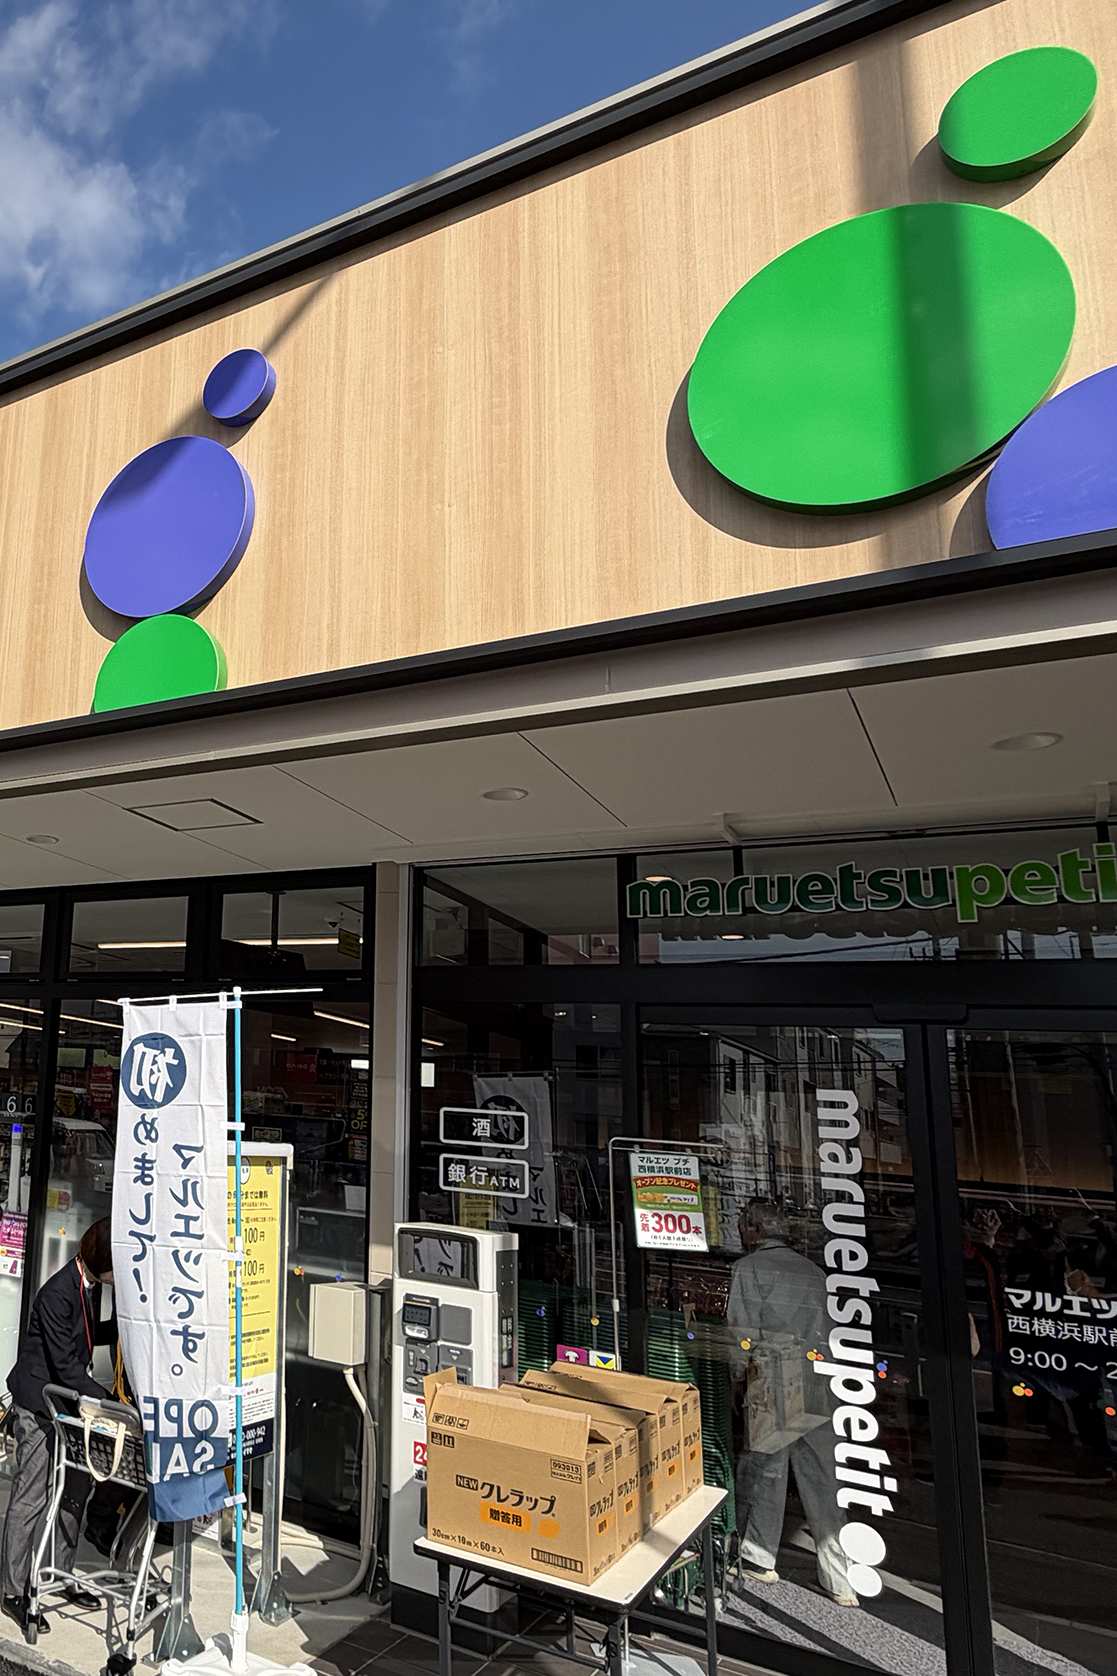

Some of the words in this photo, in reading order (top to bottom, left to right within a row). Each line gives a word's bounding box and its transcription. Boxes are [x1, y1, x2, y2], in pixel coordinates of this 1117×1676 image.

[6, 1095, 17, 1113] 6
[24, 1097, 33, 1114] 6
[472, 1117, 491, 1137] 酒
[637, 1156, 669, 1165] マルエツ
[637, 1165, 692, 1176] 西横浜駅前店
[447, 1163, 520, 1189] 銀行ATM
[651, 1212, 691, 1235] 300
[692, 1225, 702, 1235] 本
[814, 1087, 900, 1517] maruetsupetit
[1004, 1287, 1117, 1319] マルエツ
[1009, 1347, 1067, 1371] 9:00
[457, 1476, 478, 1490] NEW
[480, 1482, 557, 1515] クレラップ
[489, 1508, 523, 1528] 贈答用
